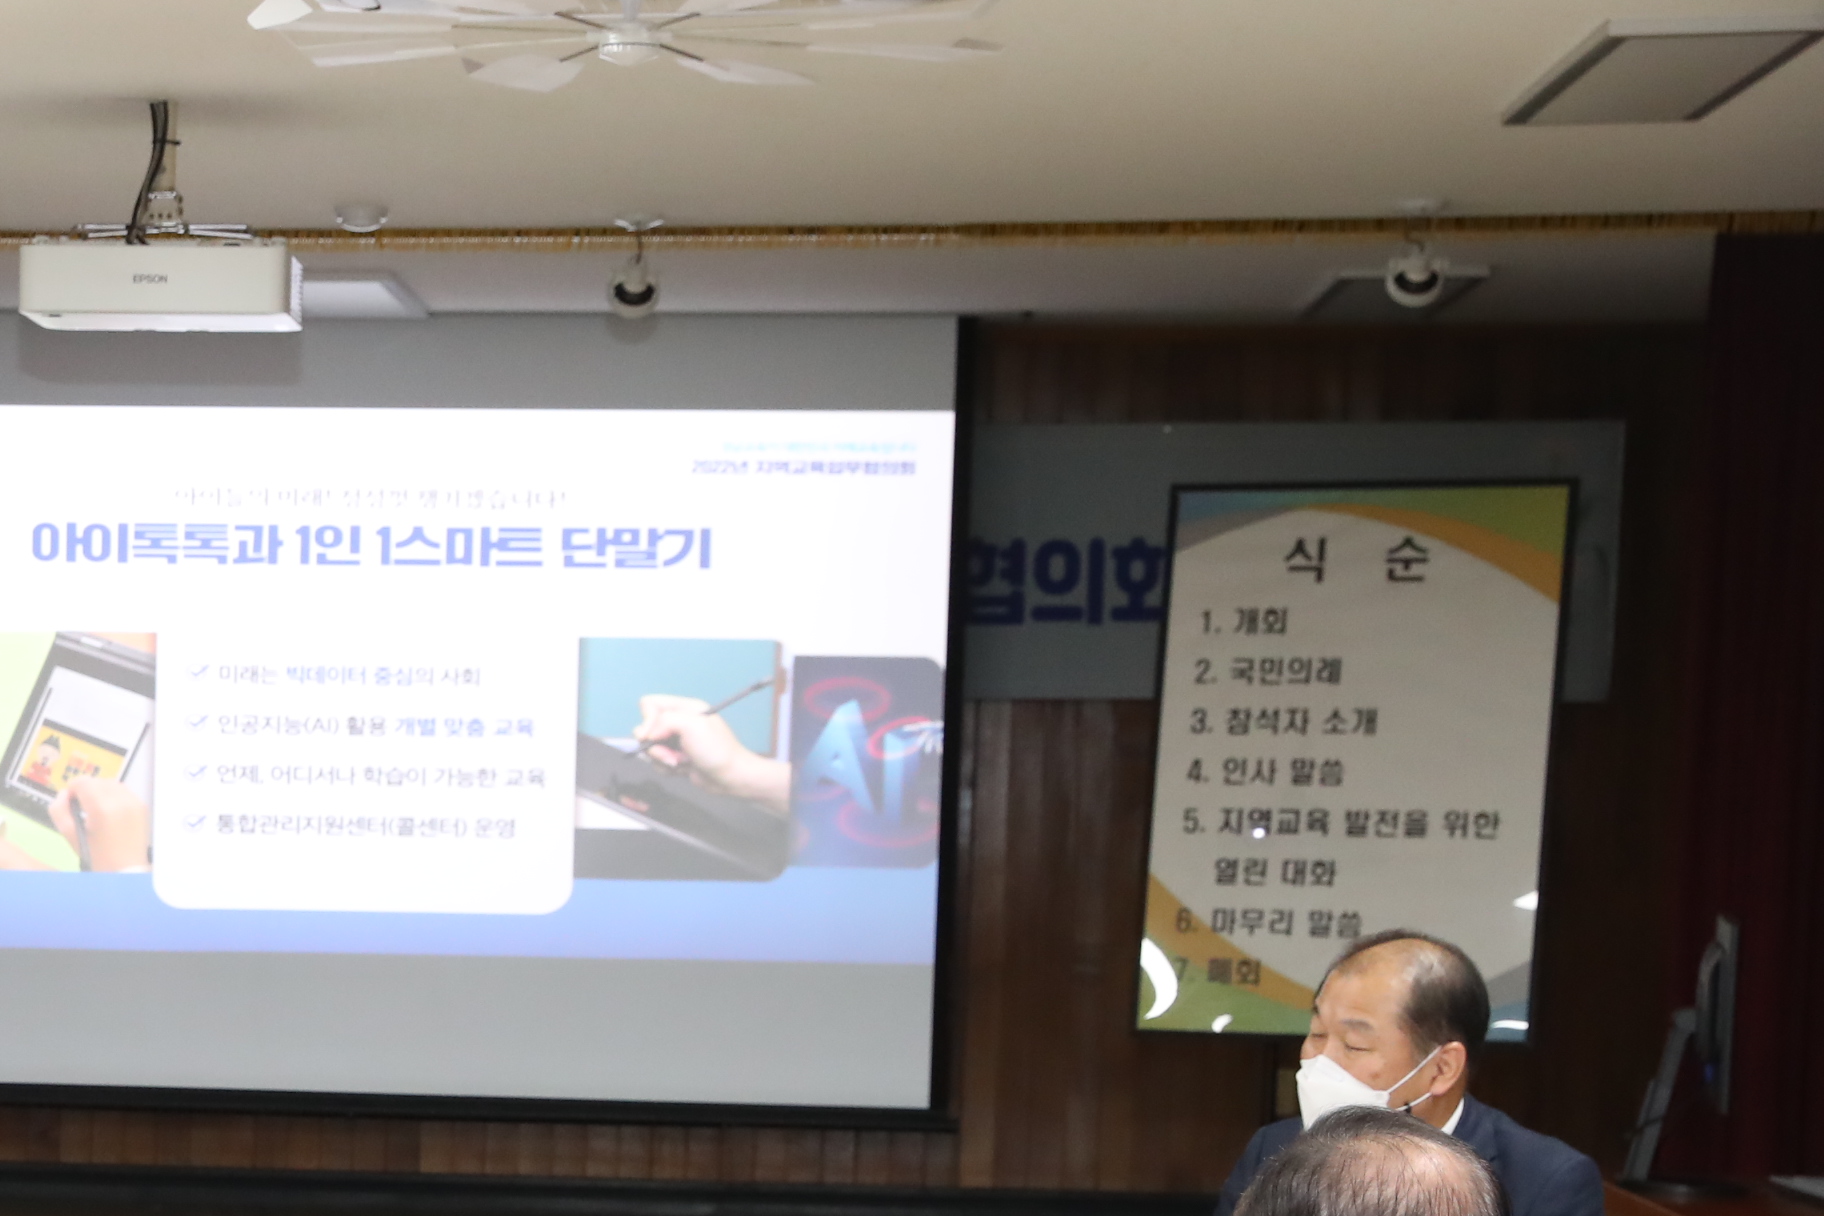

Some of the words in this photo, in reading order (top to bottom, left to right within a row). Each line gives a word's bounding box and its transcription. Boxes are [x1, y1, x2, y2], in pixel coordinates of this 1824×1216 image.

[132, 274, 169, 285] EPSON
[32, 522, 283, 565] 아이톡톡과
[295, 525, 361, 566] 1인
[376, 526, 543, 567] 1스마트
[562, 527, 712, 569] 단말기
[1201, 608, 1222, 634] 1.
[1233, 607, 1289, 635] 개회
[219, 664, 277, 685] 미래는
[286, 665, 367, 685] 빅데이터
[374, 665, 434, 686] 중심의
[440, 666, 482, 687] 사회
[1194, 657, 1218, 685] 2.
[1232, 656, 1343, 686] 국민의례
[218, 714, 340, 737] 인공지능(AI)
[346, 716, 387, 737] 활용
[395, 716, 438, 738] 개별
[444, 717, 486, 738] 맞춤
[493, 718, 536, 738] 교육
[1190, 708, 1214, 735] 3.
[1227, 707, 1311, 736] 참석자
[1322, 708, 1379, 736] 소개
[217, 764, 264, 785] 언제,
[271, 765, 357, 785] 어디서나
[363, 766, 427, 787] 학습이
[433, 766, 497, 788] 가능한
[505, 767, 548, 789] 교육
[1186, 758, 1210, 785] 4.
[1222, 757, 1277, 787] 인사
[1290, 758, 1345, 788] 말씀
[216, 813, 469, 838] 통합관리지원센터(콜센터)
[475, 817, 518, 839] 운영
[1182, 807, 1206, 835] 5.
[1218, 807, 1331, 837] 지역교육
[1344, 808, 1430, 839] 발전을
[1442, 809, 1501, 840] 위한
[1214, 856, 1269, 888] 열린
[1280, 858, 1337, 889] 대화
[1211, 907, 1295, 937] 마무리
[1308, 908, 1364, 939] 말씀
